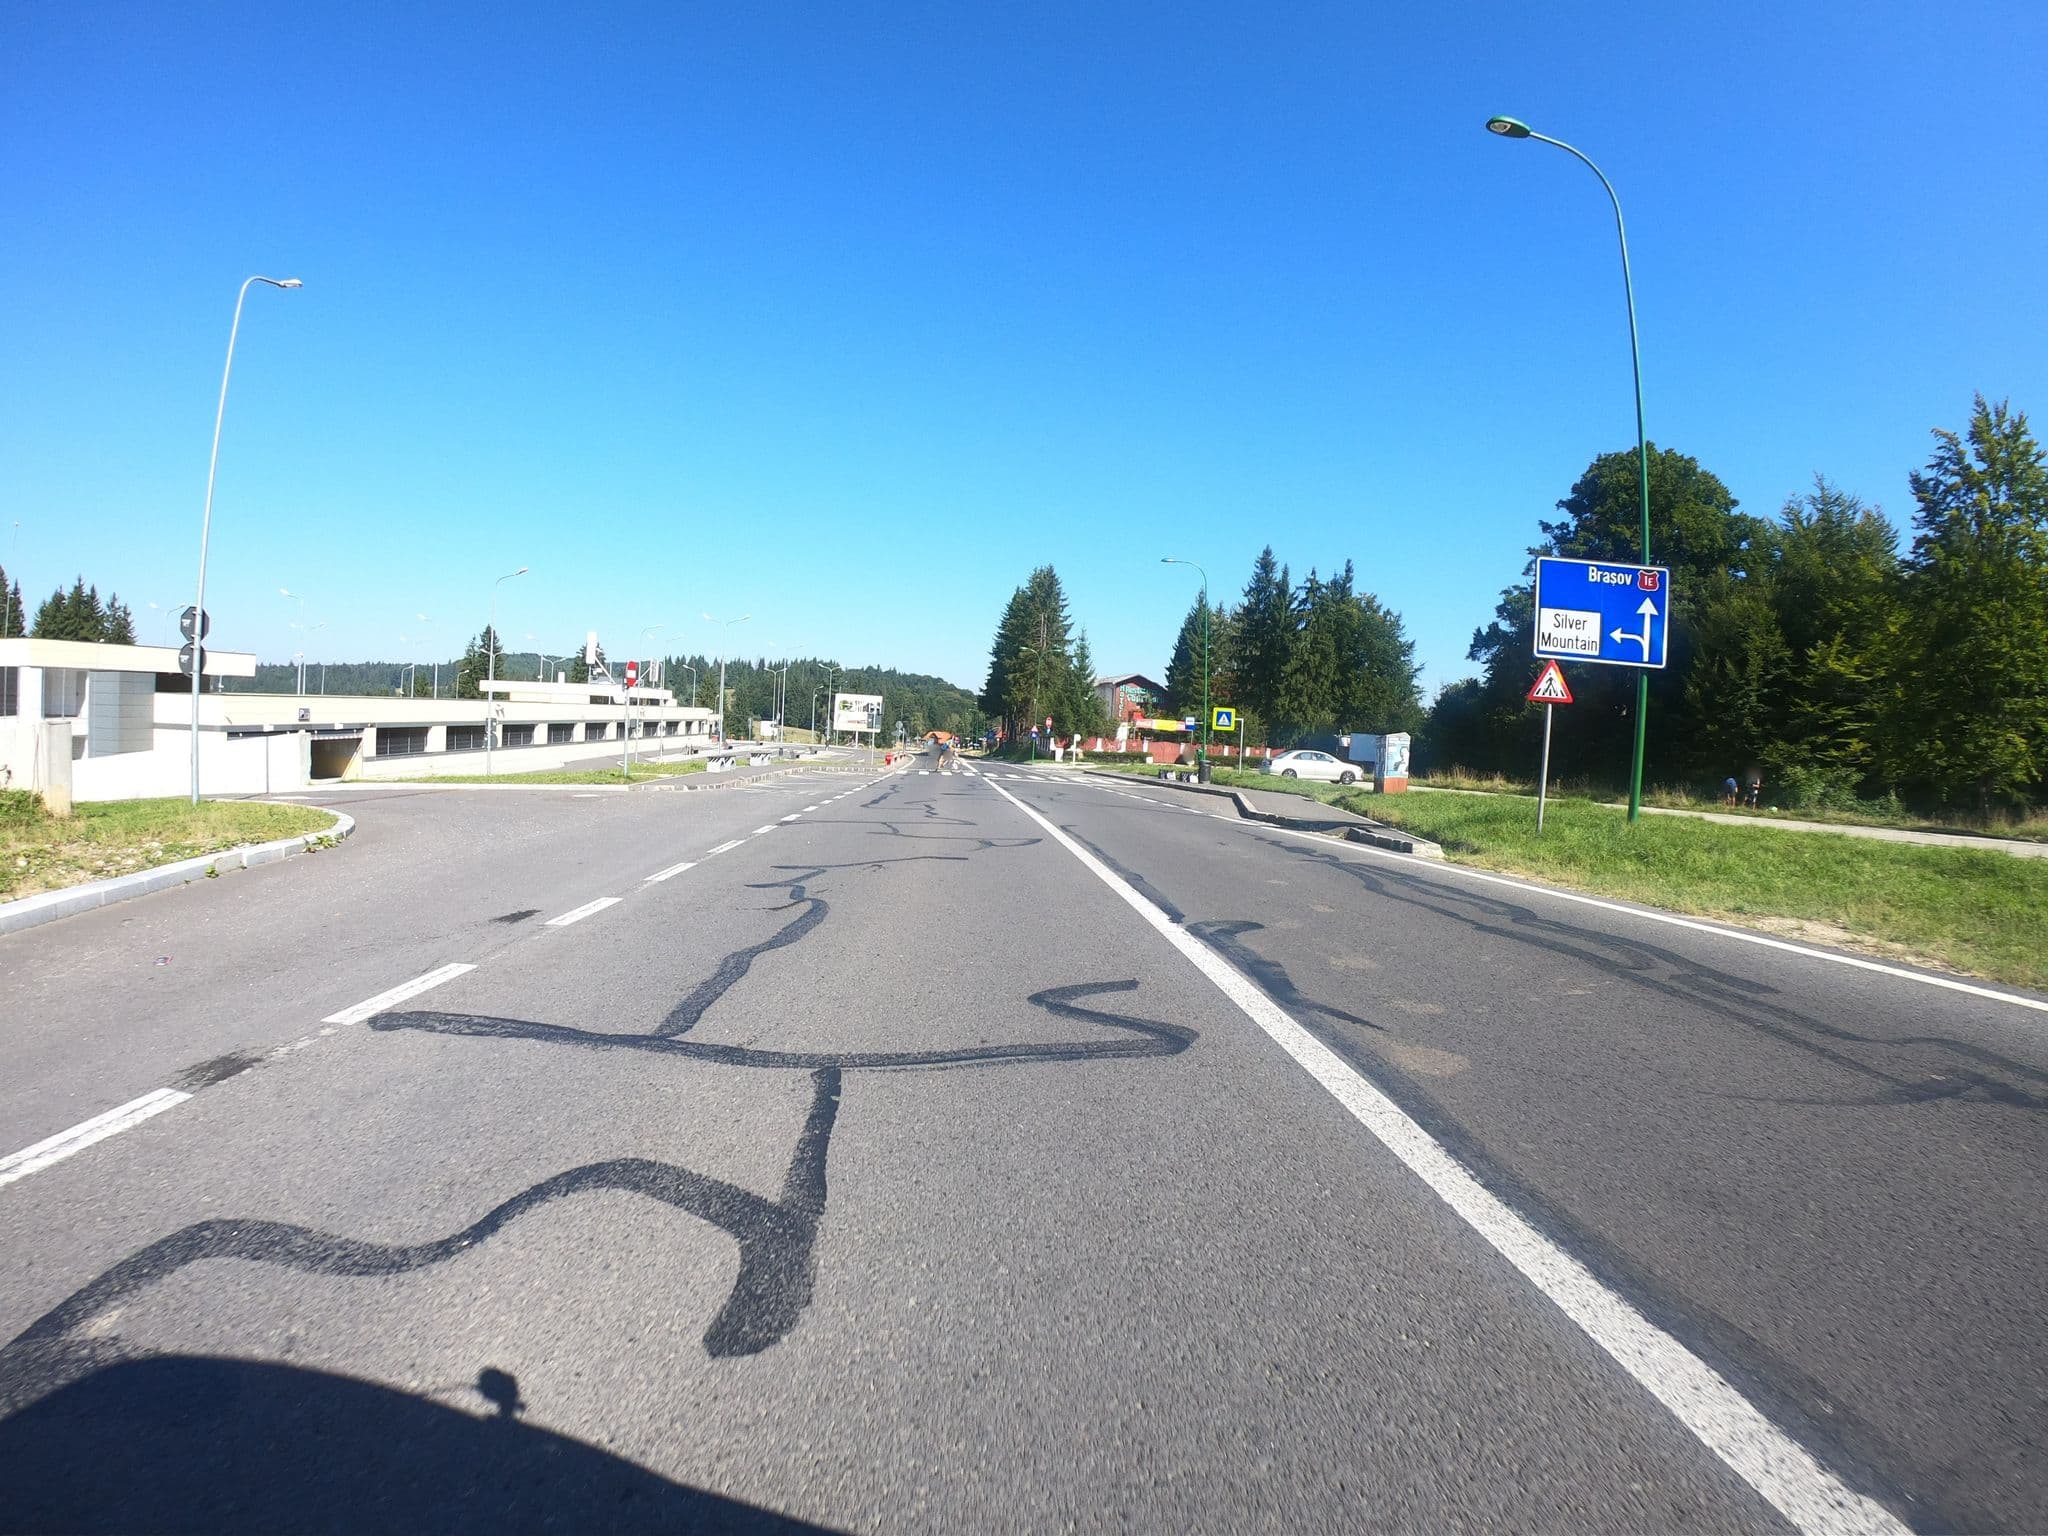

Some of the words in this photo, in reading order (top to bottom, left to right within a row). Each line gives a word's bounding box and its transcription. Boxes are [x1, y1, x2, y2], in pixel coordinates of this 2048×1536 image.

[1588, 566, 1632, 586] Brașov
[1553, 613, 1587, 631] Silver
[1541, 632, 1598, 652] Mountain
